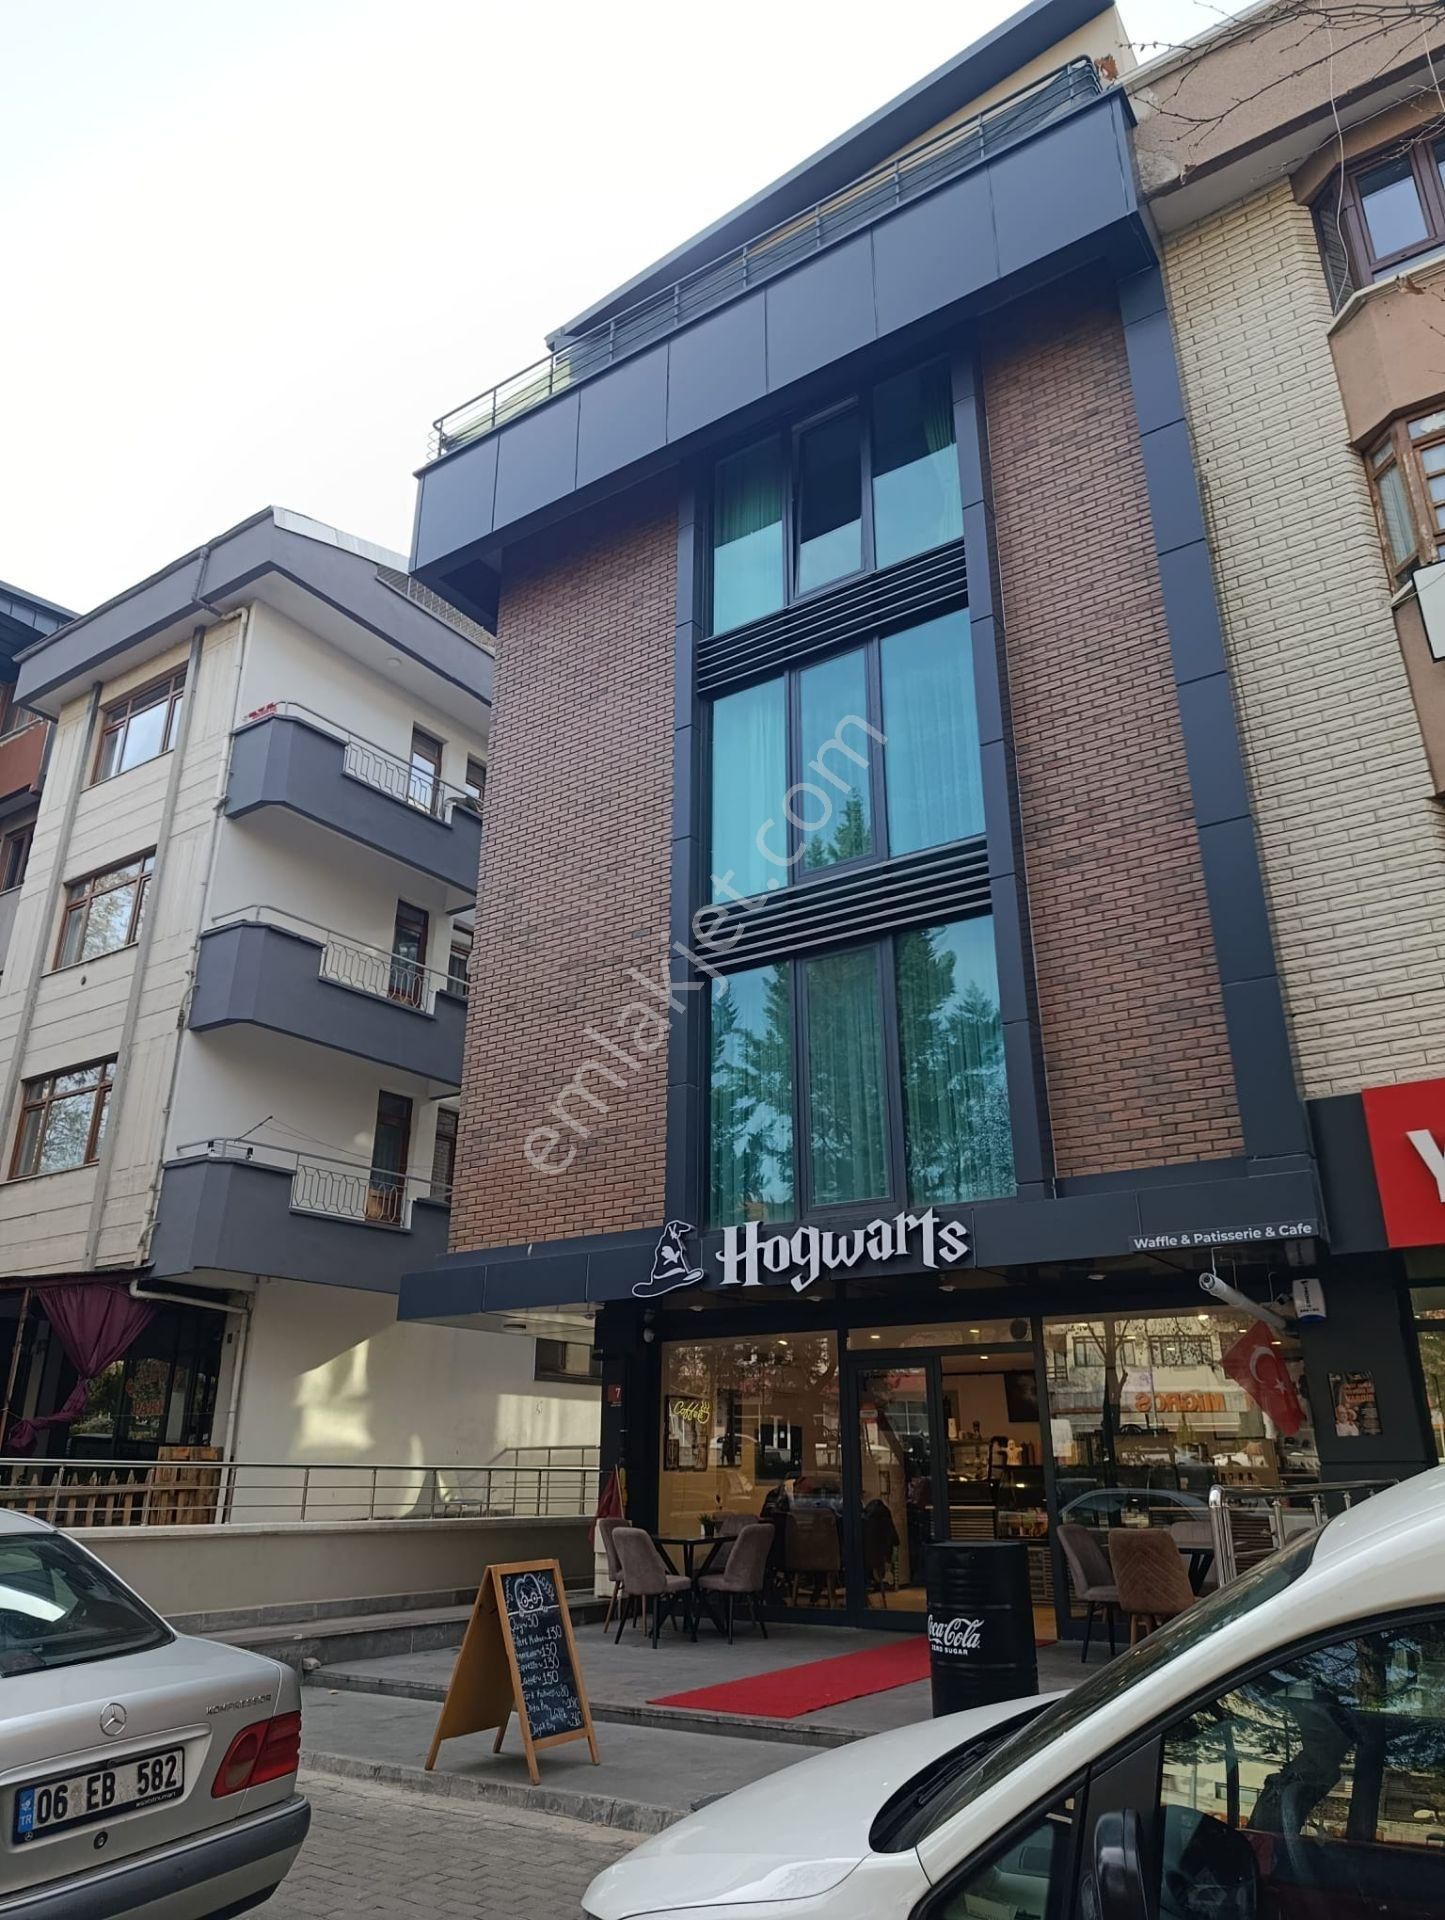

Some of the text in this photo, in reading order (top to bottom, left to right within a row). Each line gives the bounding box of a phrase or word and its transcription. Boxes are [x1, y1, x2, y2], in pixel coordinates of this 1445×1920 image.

[1133, 1222, 1313, 1249] Waffle & Patisserie & Cafe
[715, 1206, 970, 1293] Hogwarts
[944, 1647, 969, 1656] SUGAR
[37, 1784, 68, 1825] 06
[86, 1772, 116, 1811] EB
[136, 1754, 177, 1796] 582
[20, 1814, 32, 1826] TR
